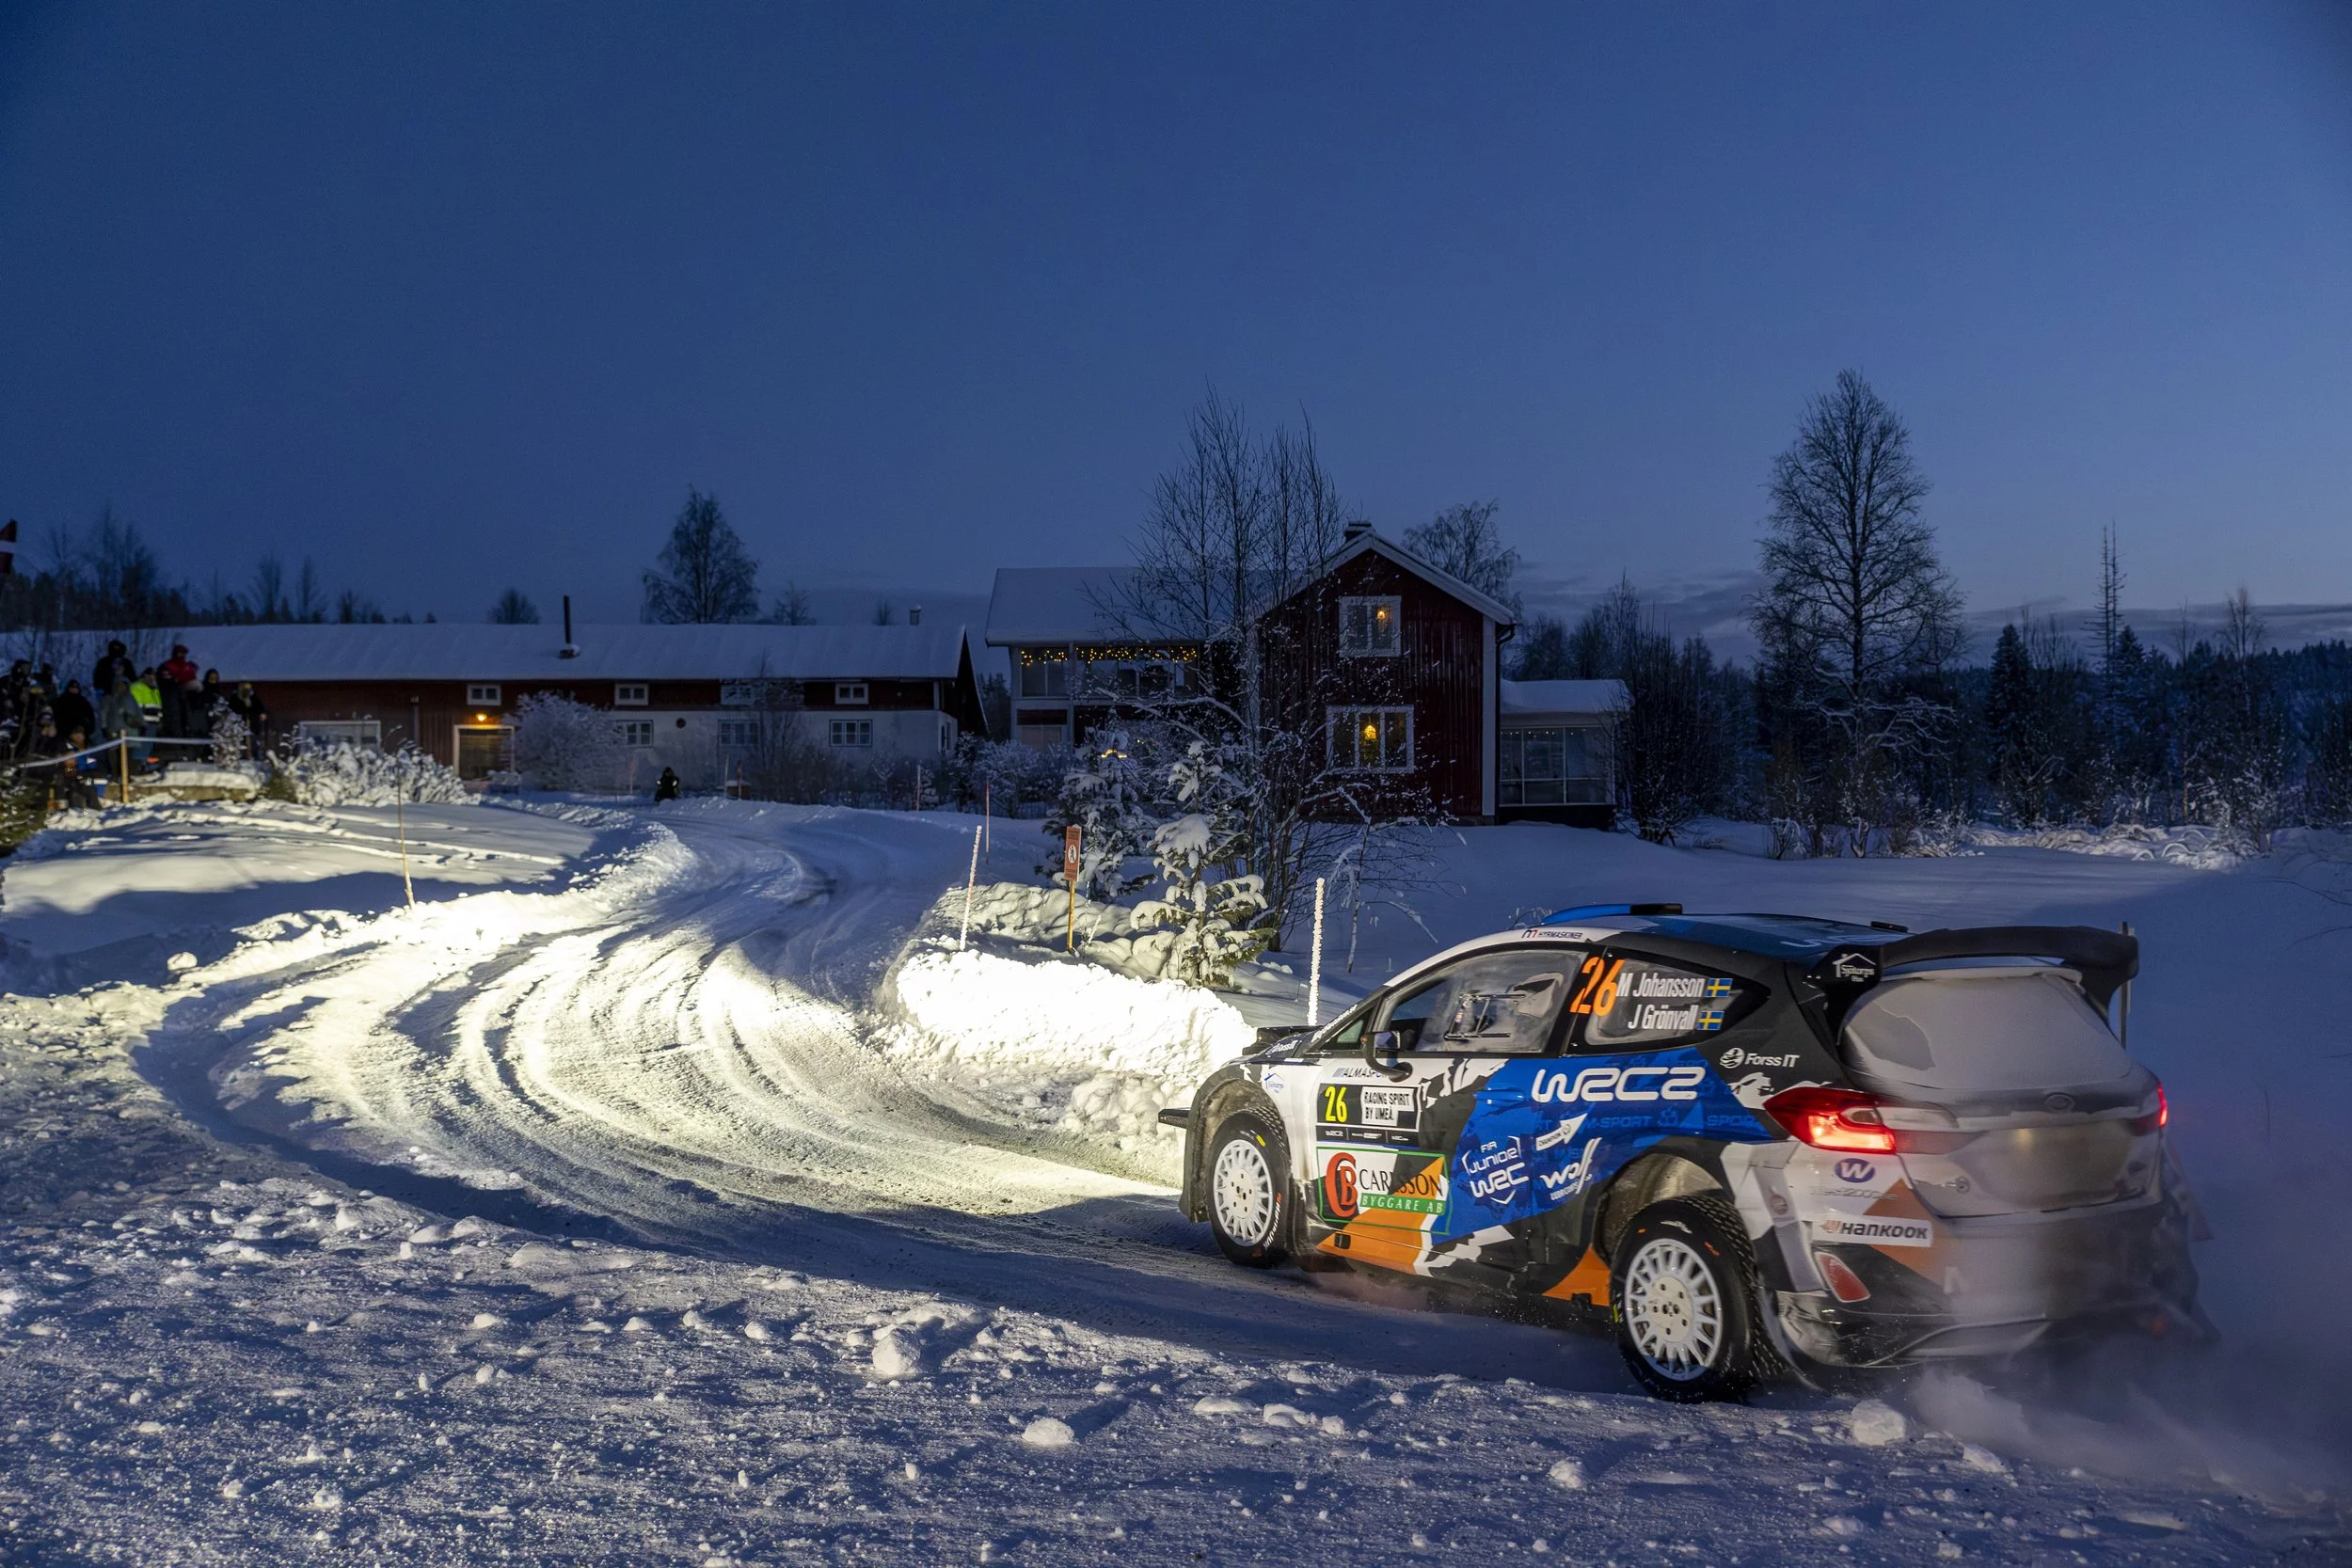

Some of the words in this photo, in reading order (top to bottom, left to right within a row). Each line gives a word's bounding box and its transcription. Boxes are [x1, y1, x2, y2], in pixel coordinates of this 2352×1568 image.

[1569, 957, 1626, 1017] 26
[1615, 973, 1633, 997] M
[1632, 972, 1705, 997] Johansson
[1628, 1005, 1643, 1029] J
[1642, 1004, 1699, 1030] Grönvall
[1745, 1053, 1783, 1067] Forss
[1782, 1054, 1801, 1068] IT
[1531, 1066, 1706, 1102] WRC2
[1325, 1085, 1347, 1122] 26
[1388, 1093, 1409, 1106] SPIRIT
[1364, 1106, 1374, 1119] BY
[1481, 1141, 1498, 1153] FIA
[1359, 1169, 1443, 1197] CARSSON
[1470, 1162, 1530, 1197] WRC
[1361, 1195, 1420, 1212] BYGGARE
[1425, 1202, 1443, 1213] AB
